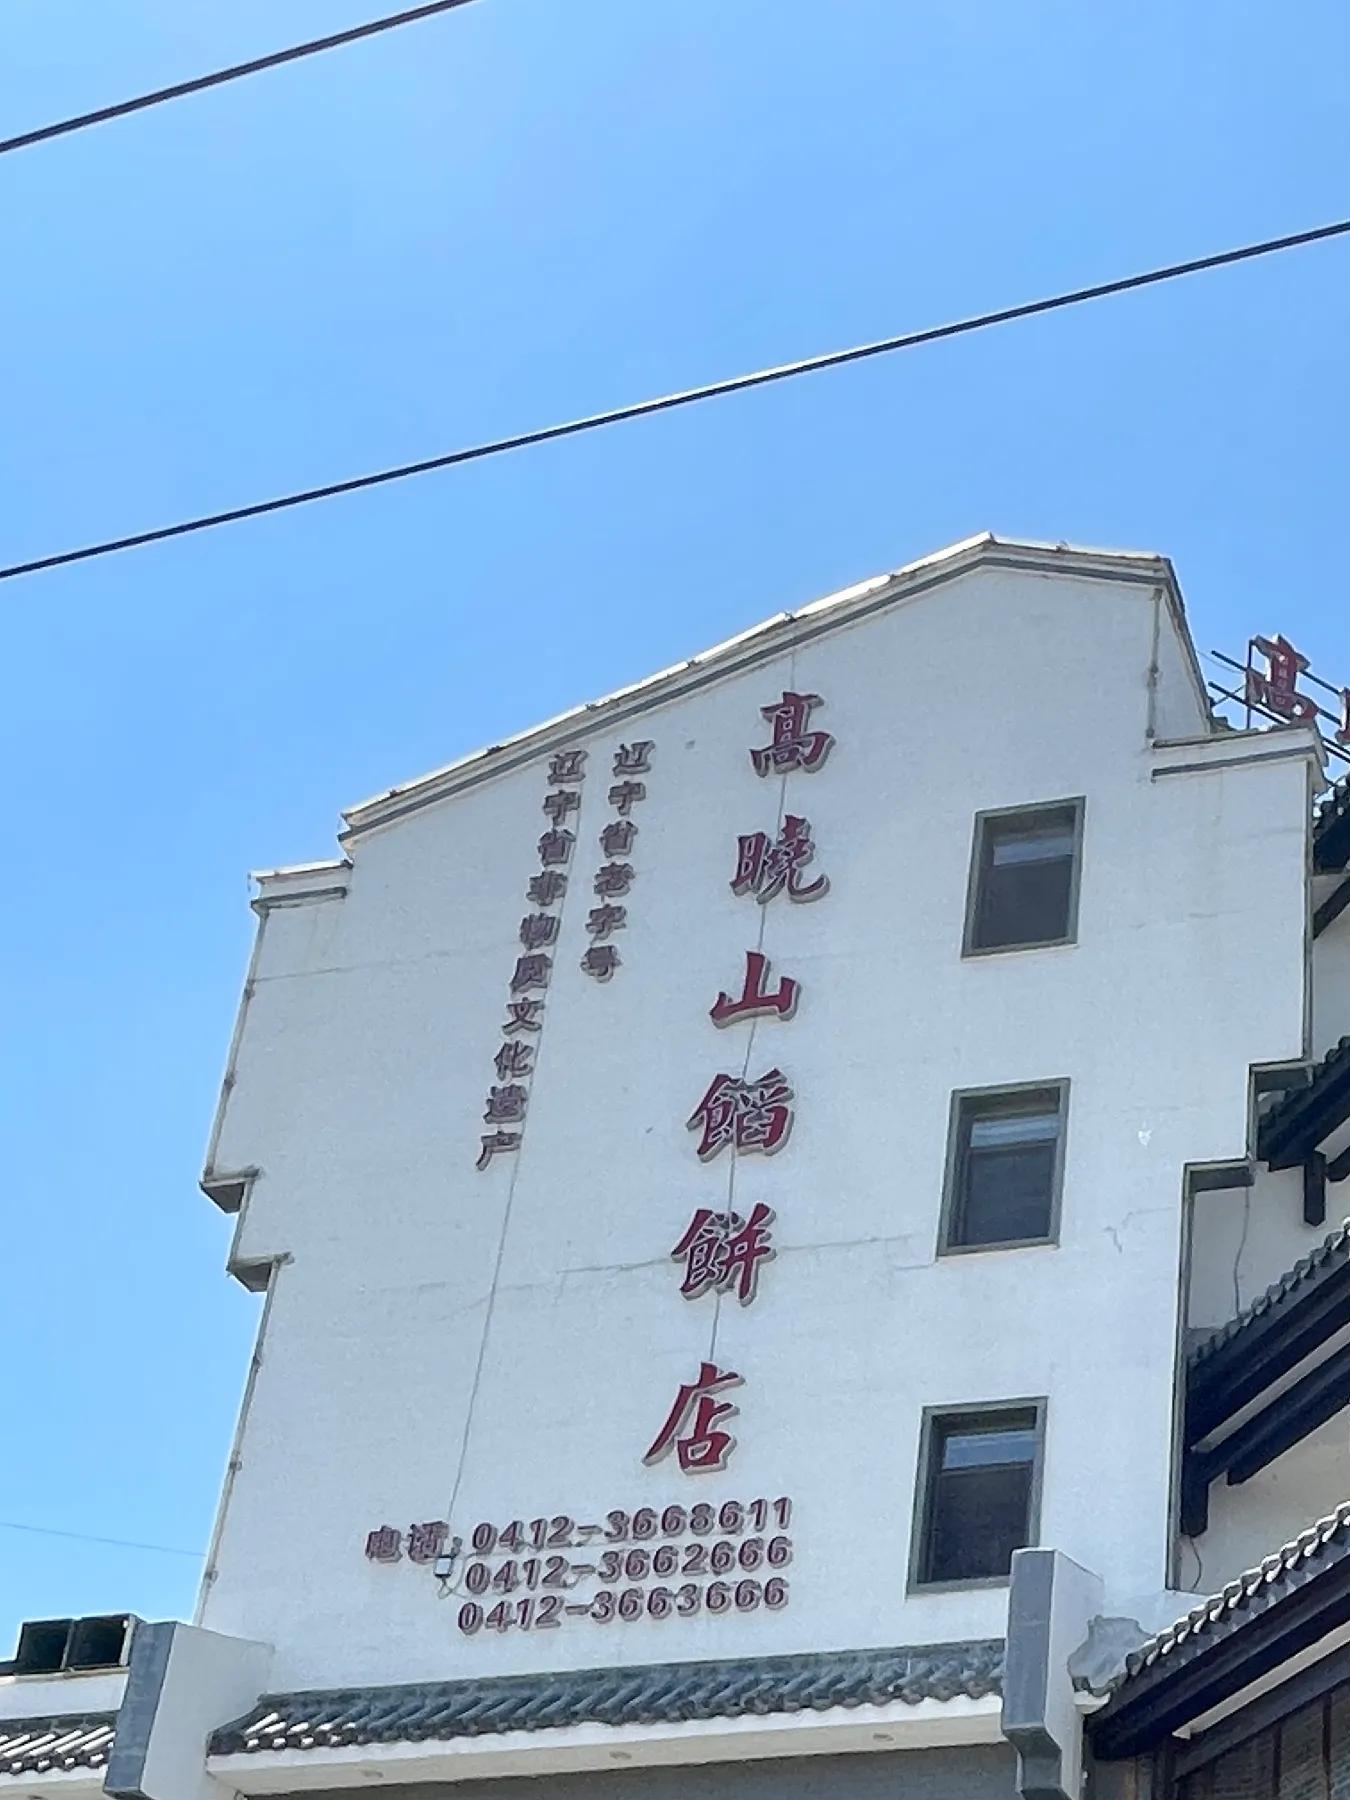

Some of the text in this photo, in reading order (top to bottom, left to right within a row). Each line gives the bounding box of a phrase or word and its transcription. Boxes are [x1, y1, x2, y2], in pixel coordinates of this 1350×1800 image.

[474, 749, 589, 1172] 辽宁省非物质文化遗产
[580, 740, 655, 984] 辽宁省老字号
